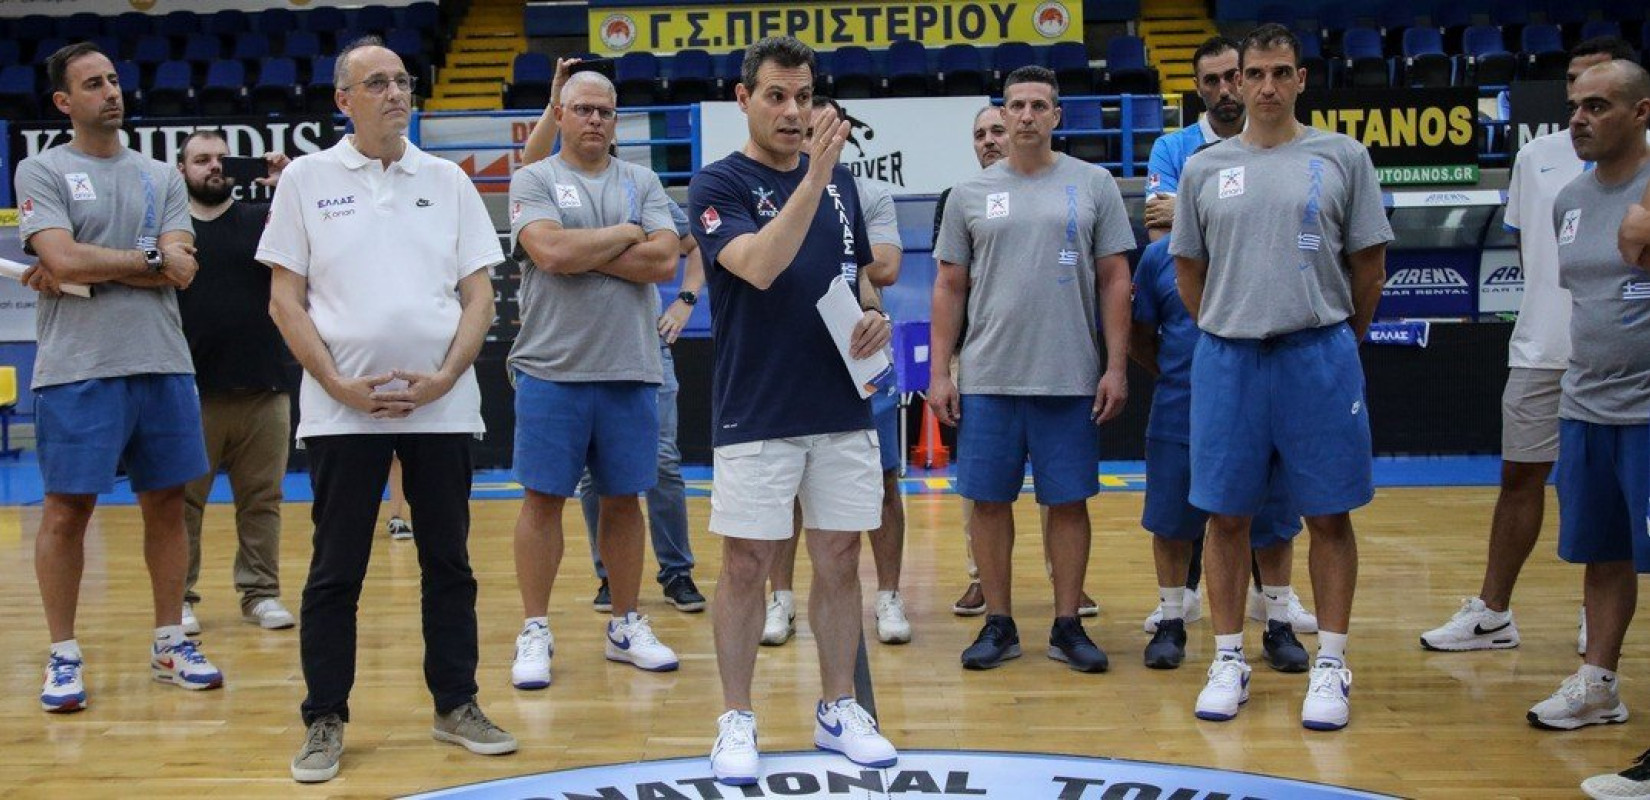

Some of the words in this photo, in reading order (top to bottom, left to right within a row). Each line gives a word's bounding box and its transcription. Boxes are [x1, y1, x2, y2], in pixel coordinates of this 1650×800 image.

[840, 150, 905, 187] OVER
[1383, 267, 1469, 288] ARENA
[519, 770, 988, 800] NATIONAL
